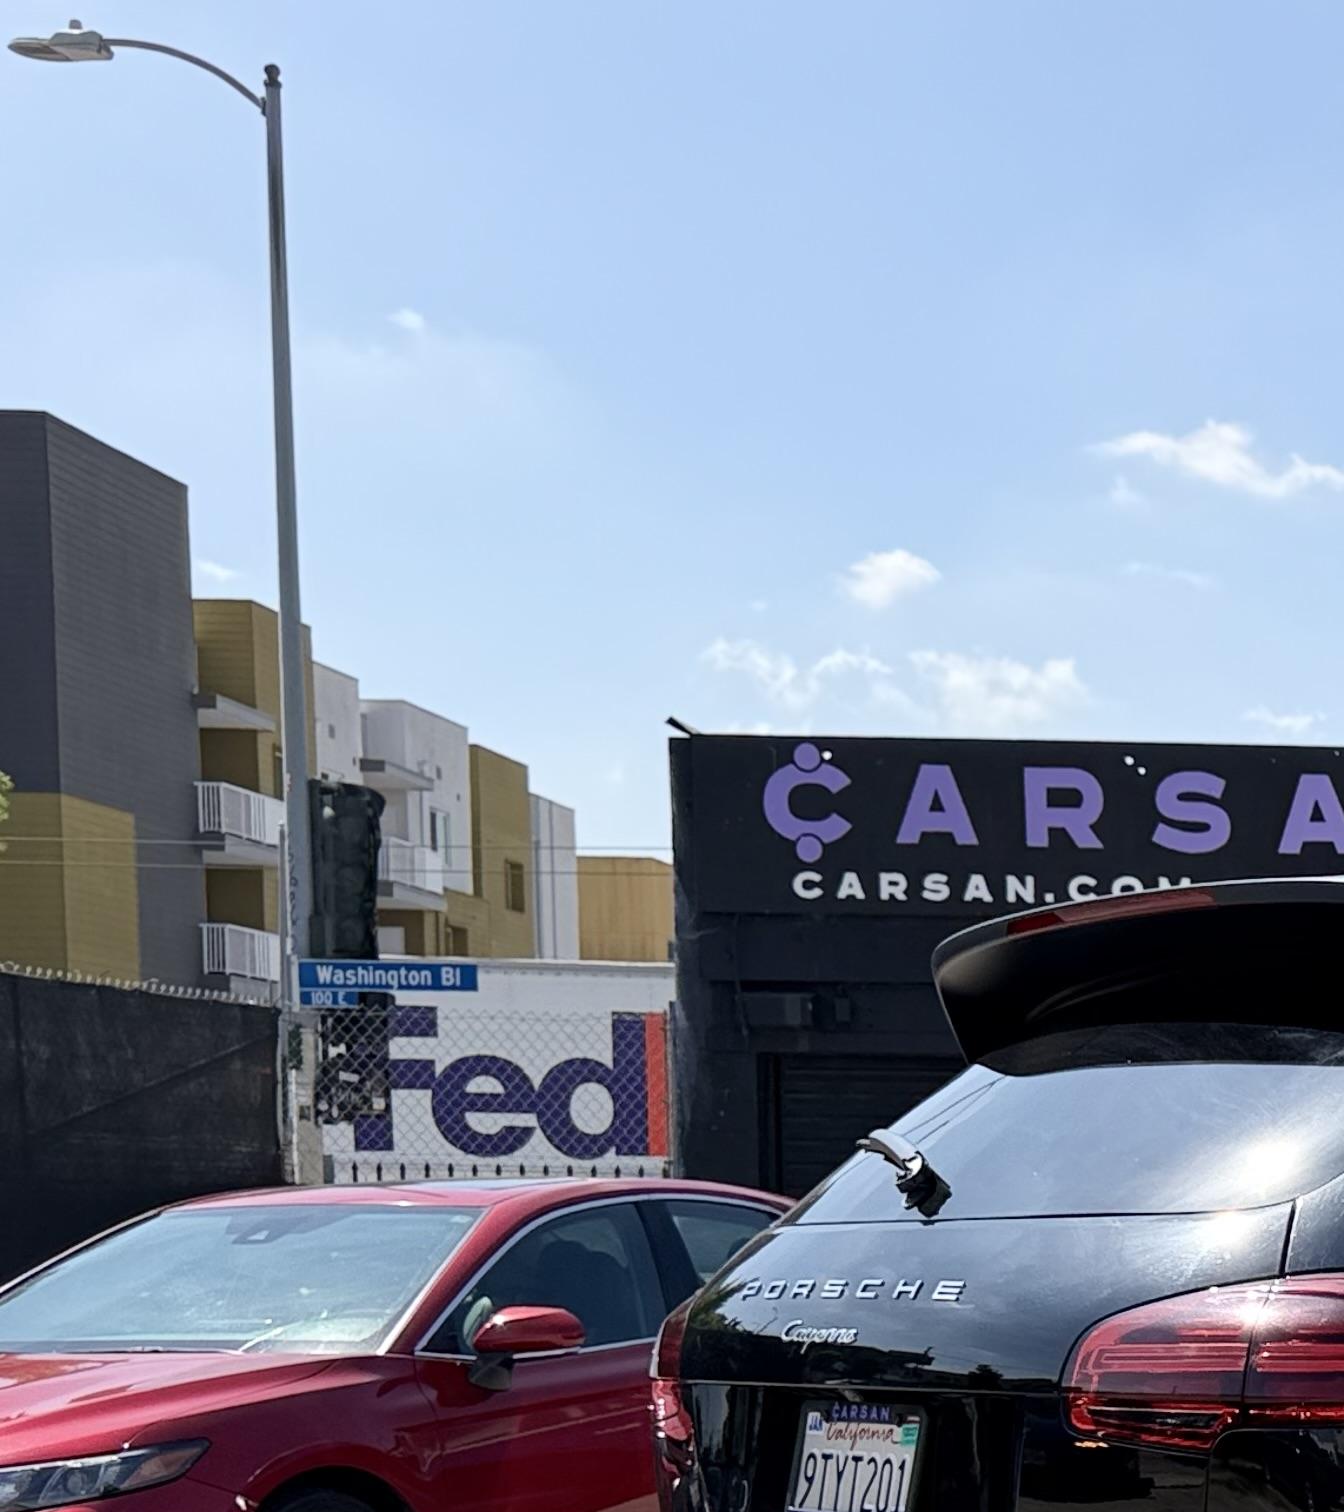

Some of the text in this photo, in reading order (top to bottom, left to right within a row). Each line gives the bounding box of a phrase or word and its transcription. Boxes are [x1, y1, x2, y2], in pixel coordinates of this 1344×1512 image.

[316, 965, 461, 989] Washington Bl
[311, 992, 347, 1005] 100 E
[354, 1005, 668, 1158] Fed
[742, 1278, 967, 1301] PORSCHE
[781, 1319, 859, 1354] Cayenne
[832, 1402, 890, 1420] CARSAN
[826, 1423, 902, 1451] California
